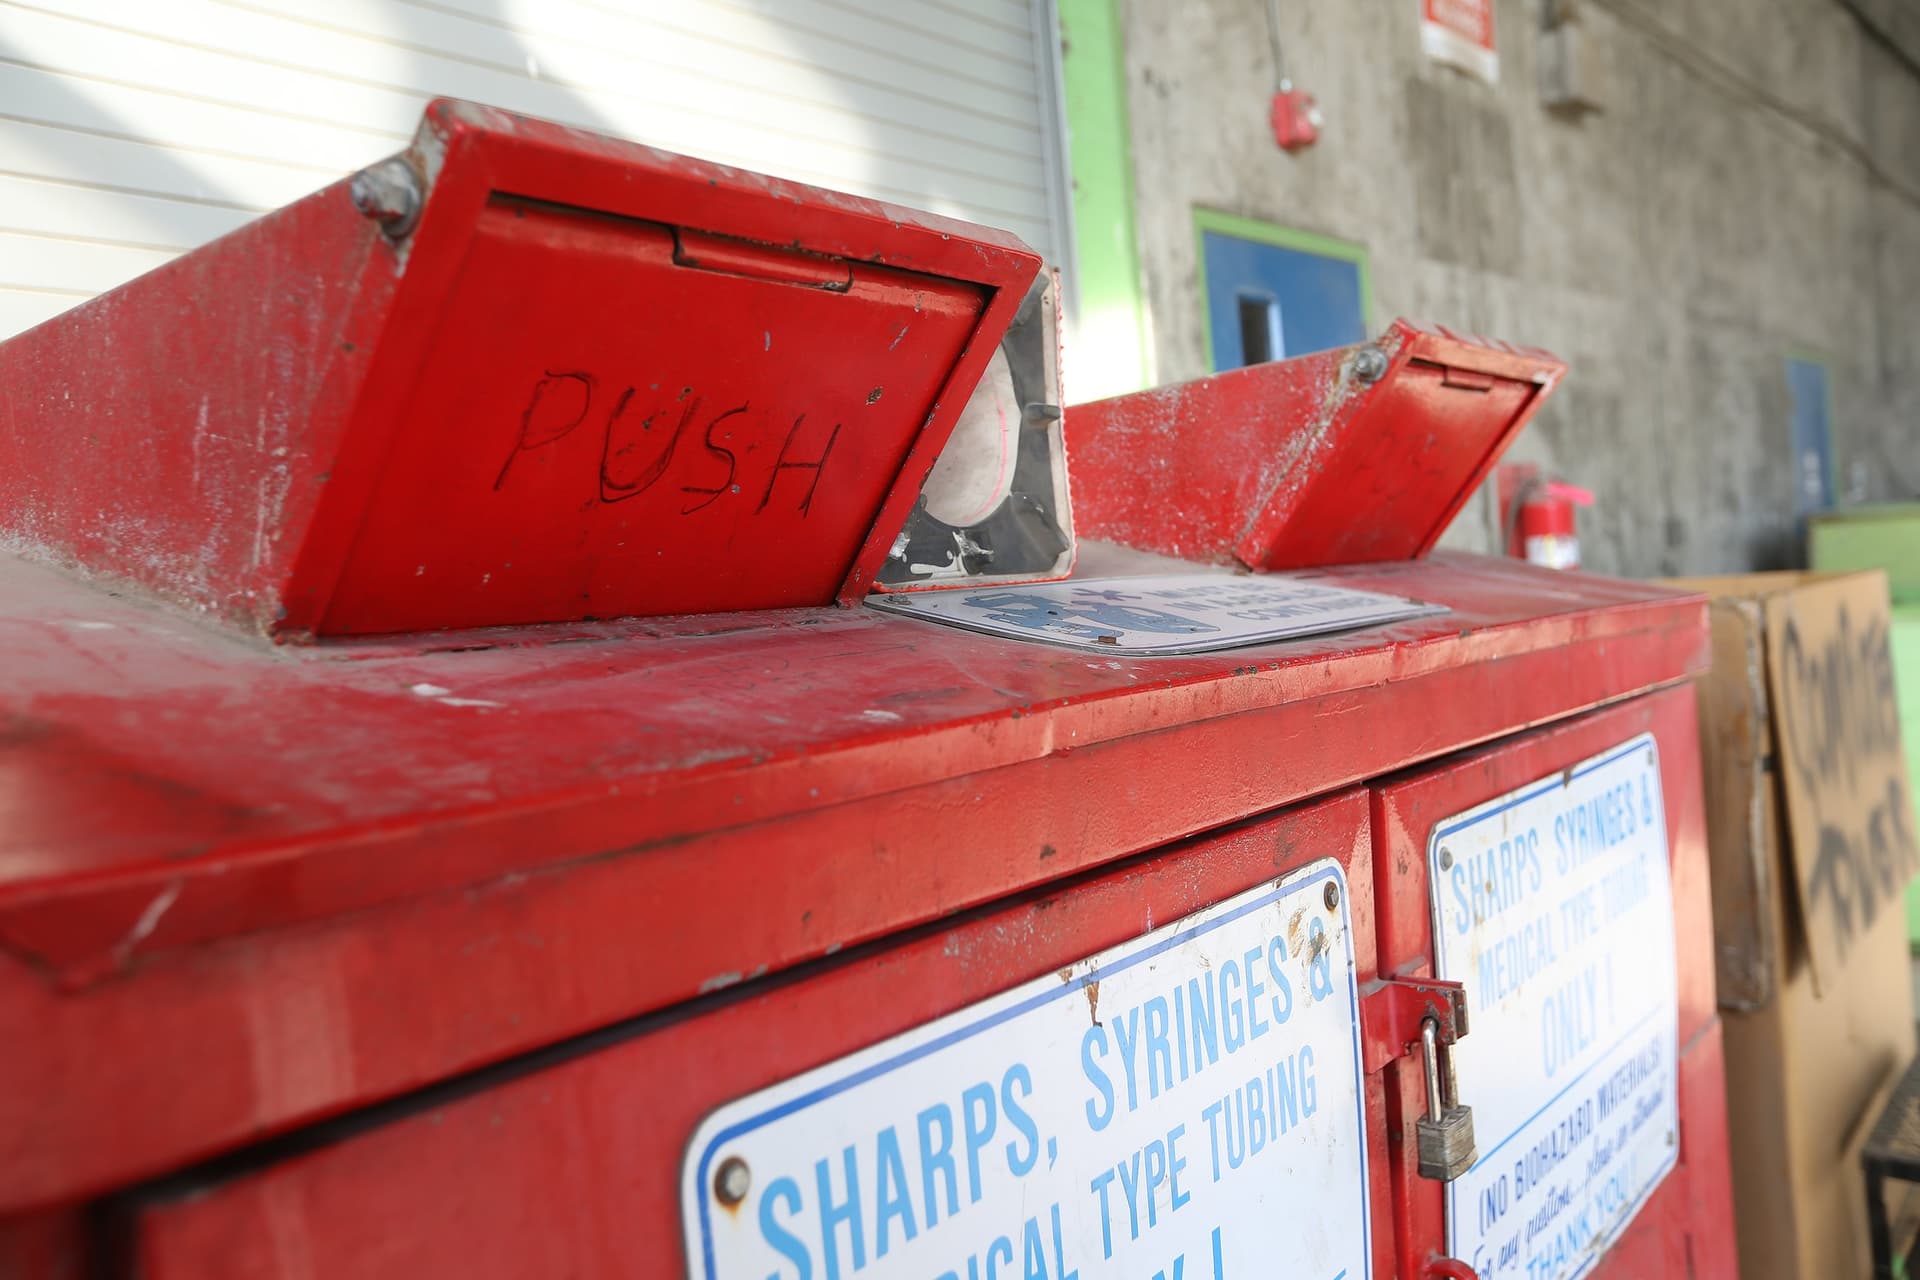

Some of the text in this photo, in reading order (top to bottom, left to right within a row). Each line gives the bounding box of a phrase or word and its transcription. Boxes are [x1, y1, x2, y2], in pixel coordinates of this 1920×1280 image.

[494, 369, 842, 519] PUSH
[1477, 911, 1558, 1012] MEDICAL
[1541, 963, 1598, 1078] ONLY
[758, 916, 1336, 1280] SHARPS, SYRINGES &
[1091, 1123, 1192, 1260] TYPE
[1201, 1044, 1318, 1182] TUBING
[1480, 1172, 1508, 1238] (NO
